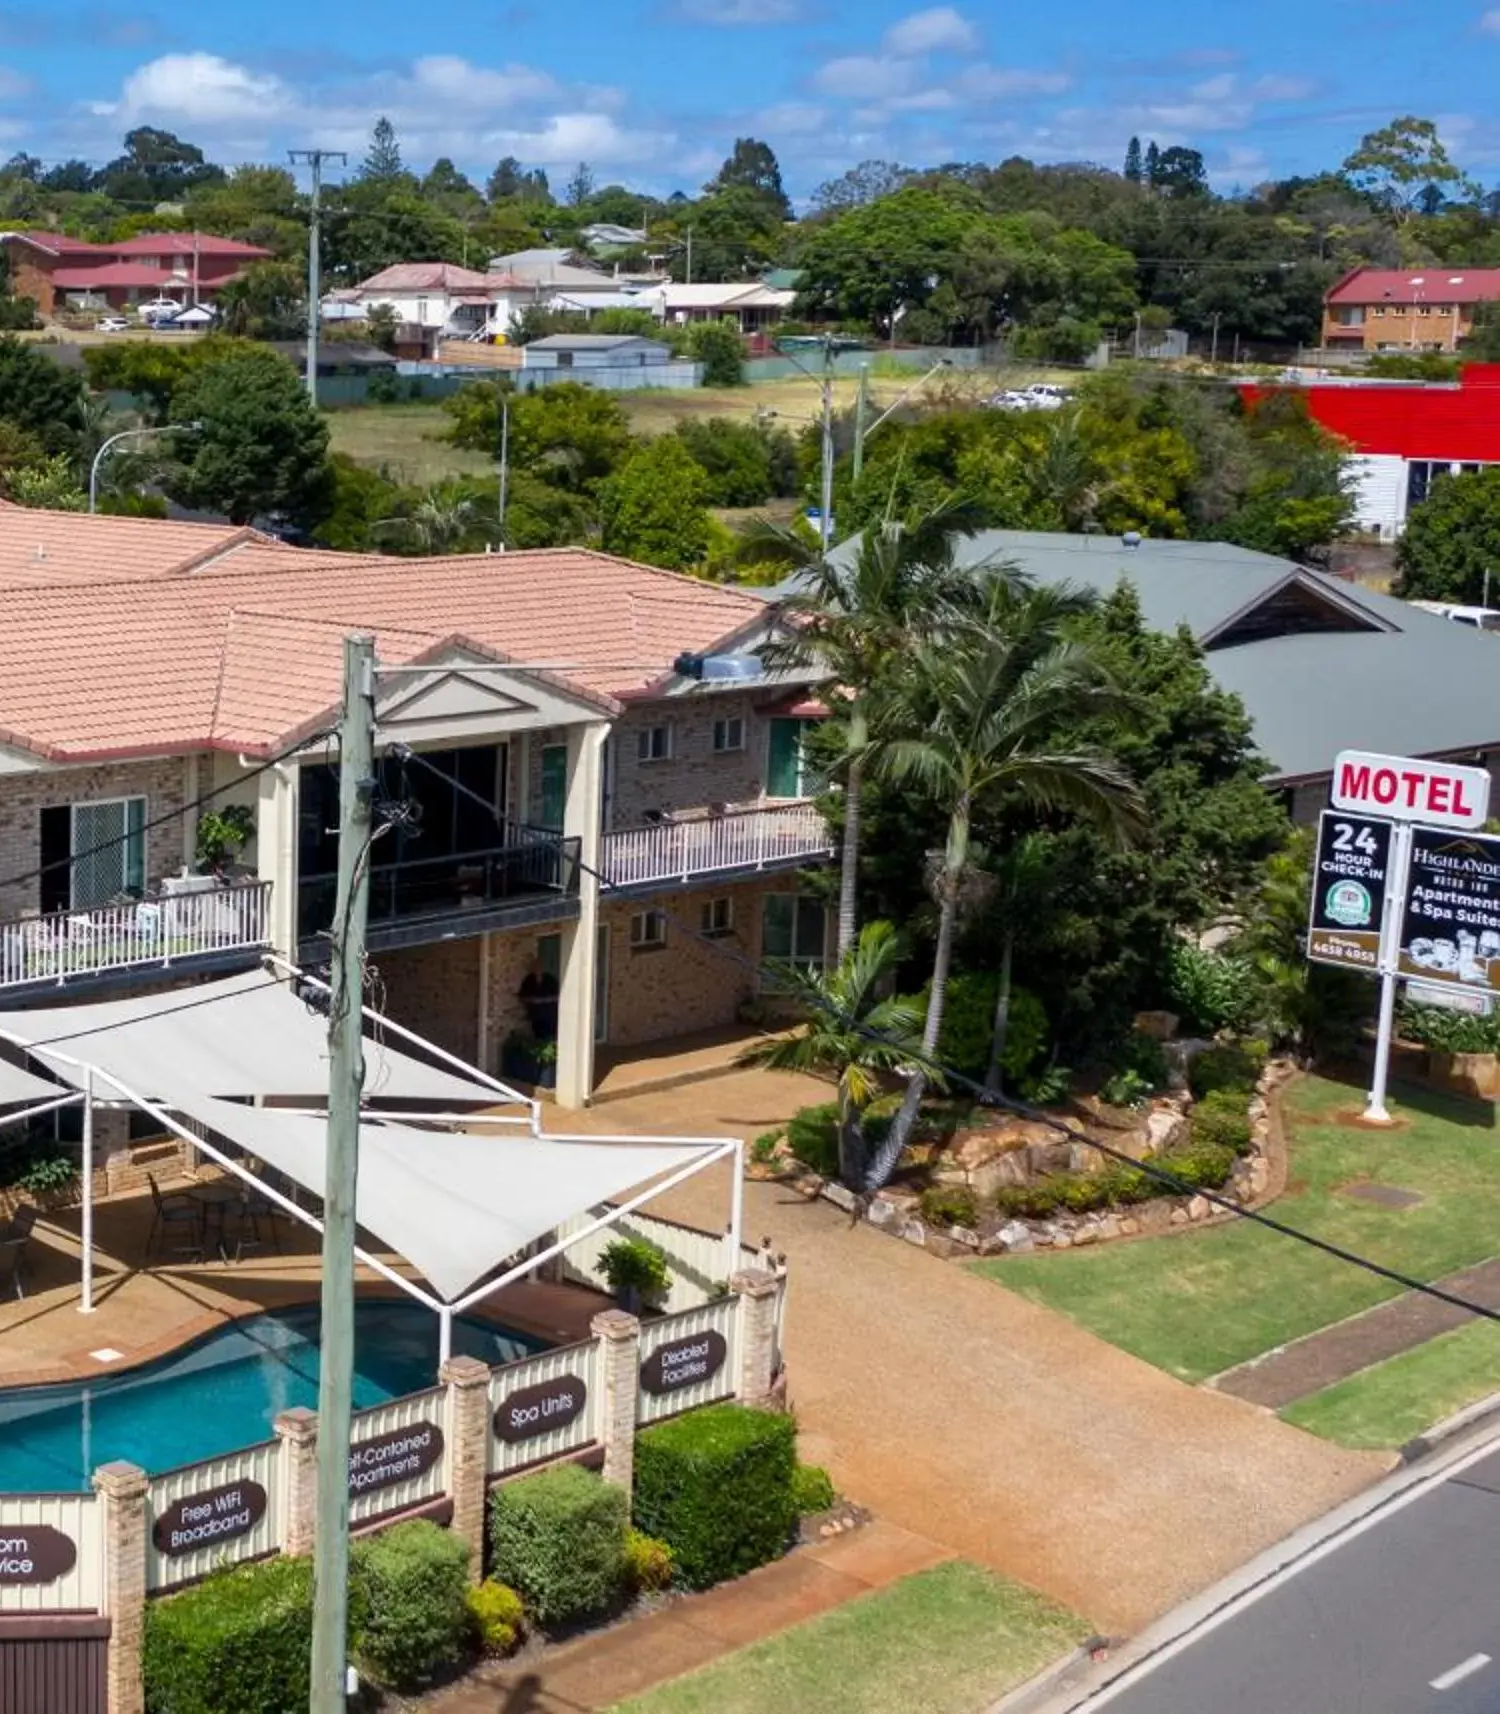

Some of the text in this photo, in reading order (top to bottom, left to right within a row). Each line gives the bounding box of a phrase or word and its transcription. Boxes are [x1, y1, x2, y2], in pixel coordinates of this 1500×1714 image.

[1340, 763, 1473, 817] MOTEL
[1331, 823, 1378, 855] 24
[1321, 861, 1383, 880] CHECK-IN
[1335, 852, 1373, 867] HOUR
[1413, 847, 1500, 876] HIGHLANDE
[1410, 901, 1420, 913] &
[1423, 903, 1452, 920] Spa
[1412, 885, 1500, 911] Apartment
[662, 1340, 709, 1367] Disabled
[661, 1360, 707, 1385] Facilities
[510, 1391, 573, 1429] Spa Units
[348, 1429, 431, 1469] elf-Contained
[171, 1507, 250, 1548] Broadband
[181, 1503, 212, 1525] Free
